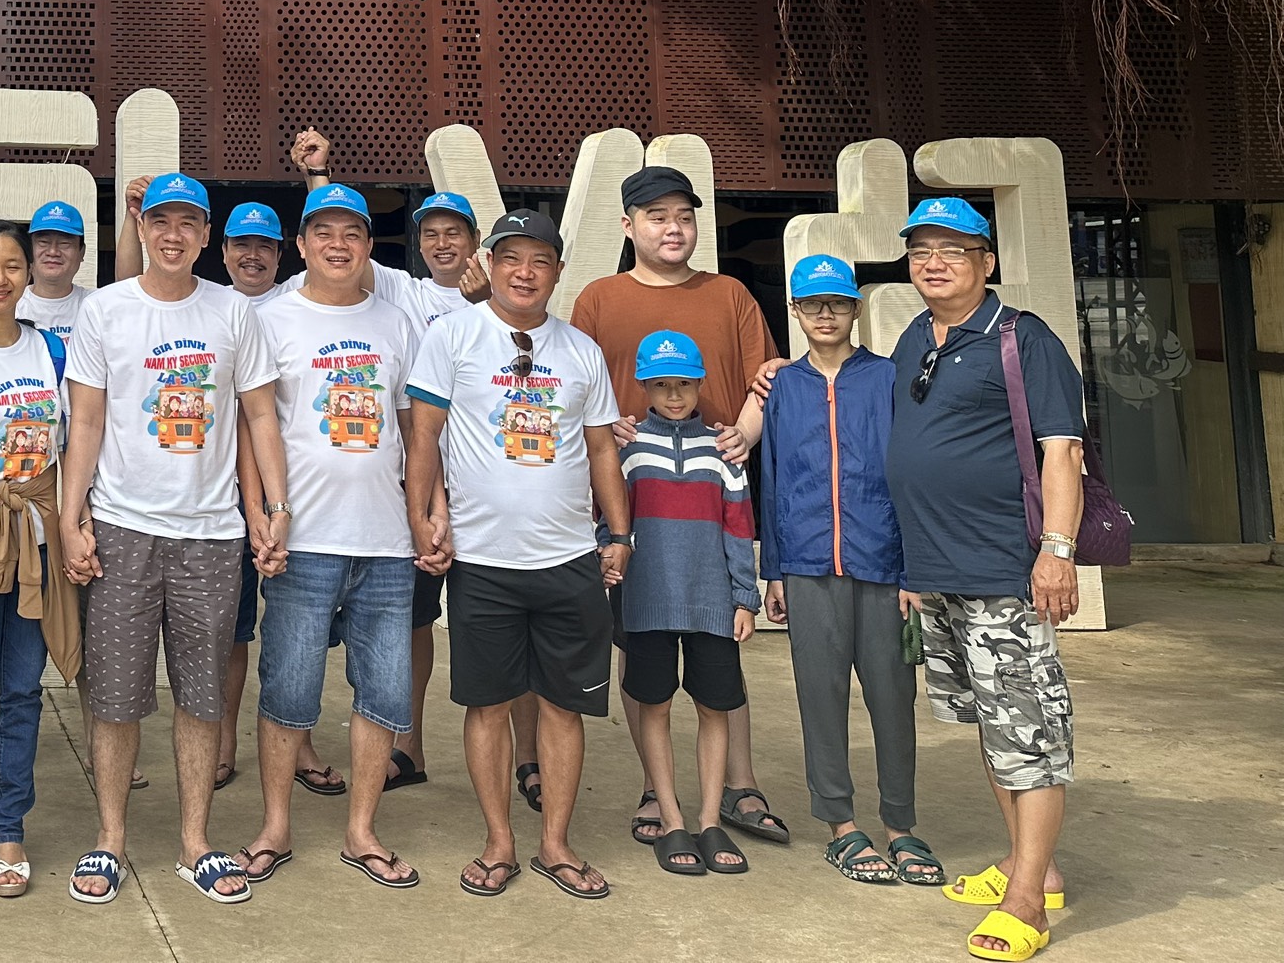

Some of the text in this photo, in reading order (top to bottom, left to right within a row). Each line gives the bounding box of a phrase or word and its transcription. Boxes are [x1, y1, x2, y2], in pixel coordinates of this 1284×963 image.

[152, 343, 173, 356] GIA
[318, 343, 338, 356] GIA
[144, 358, 165, 369] NAM
[179, 353, 216, 367] SECURITY
[311, 358, 332, 369] NAM
[346, 354, 382, 368] SECURITY
[491, 375, 512, 387] NAM
[526, 377, 562, 387] SECURITY
[23, 390, 57, 403] SECURITY
